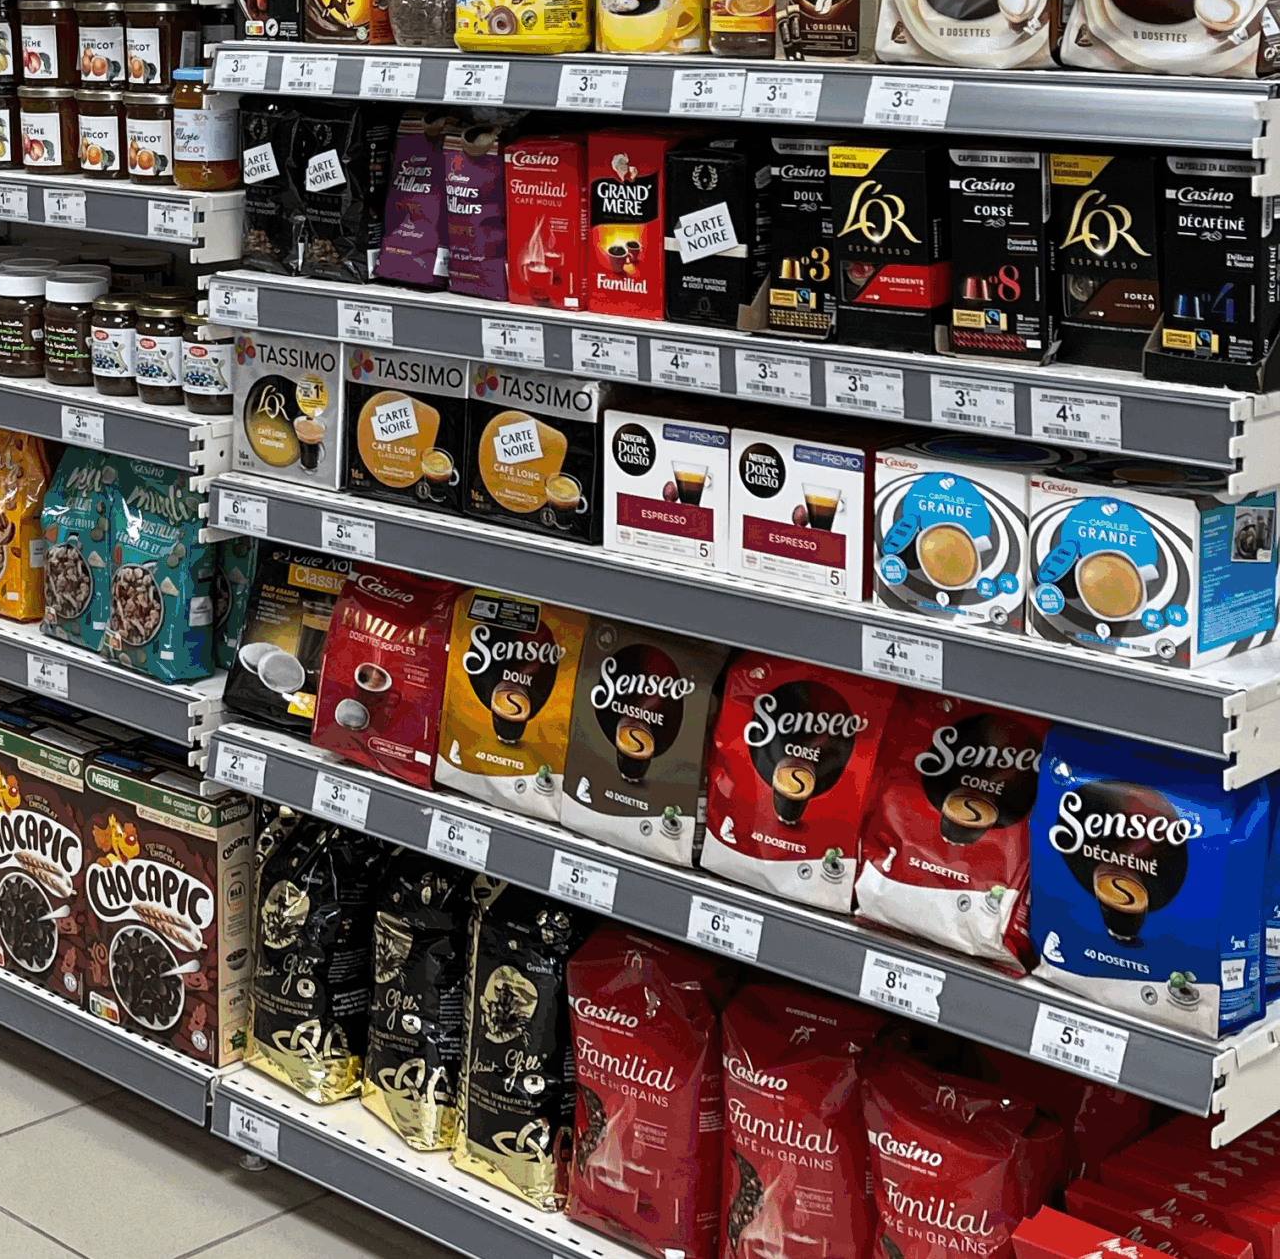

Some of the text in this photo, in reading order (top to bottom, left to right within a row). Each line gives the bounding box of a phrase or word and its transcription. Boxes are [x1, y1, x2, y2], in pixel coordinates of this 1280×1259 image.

[804, 22, 852, 31] L'ORIGINAL
[939, 27, 991, 38] 8 DOSETTES
[513, 151, 559, 166] Casino
[510, 178, 567, 198] Familial
[597, 182, 652, 201] GRAND'
[794, 191, 823, 201] DOUX
[1177, 187, 1234, 203] Casino
[515, 197, 562, 208] CAFÉ MOULU
[974, 203, 1014, 217] CORSÉ
[683, 213, 726, 238] CARTE
[1179, 214, 1245, 230] DÉCAFÉINÉ
[687, 228, 730, 252] NOIRE
[848, 244, 910, 256] ESPRESSO
[596, 273, 648, 295] Familial
[879, 276, 924, 287] SPLENDENTE
[1124, 292, 1155, 301] FORZA
[256, 344, 336, 372] TASSIMO
[500, 378, 593, 412] TASSIMO
[379, 406, 408, 424] CARTE
[380, 419, 413, 436] NOIRE
[372, 441, 417, 456] CAFÉ LONG
[618, 439, 650, 453] Dolce
[618, 452, 649, 467] Gusto
[822, 454, 859, 468] PREMIO
[769, 532, 818, 550] ESPRESSO
[1076, 526, 1138, 546] GRANDE
[358, 576, 415, 603] Casino
[462, 625, 567, 675] Senseo
[502, 669, 533, 687] DOUX
[591, 657, 695, 708] Senseo
[611, 700, 664, 725] CLASSIQUE
[743, 694, 868, 747] Senseo
[784, 743, 821, 762] CORSÉ
[92, 770, 120, 792] Nestlé
[960, 774, 1004, 795] CORSÉ
[1049, 792, 1203, 855] Senseo
[1083, 844, 1158, 877] DÉCAFÉINÉ
[90, 872, 210, 922] CHOCAPIC
[1084, 948, 1150, 974] 40 DOSETTES
[574, 998, 639, 1028] Casino
[576, 1035, 675, 1093] Familial
[579, 1067, 607, 1087] CAFÉ
[620, 1083, 669, 1107] GRAINS
